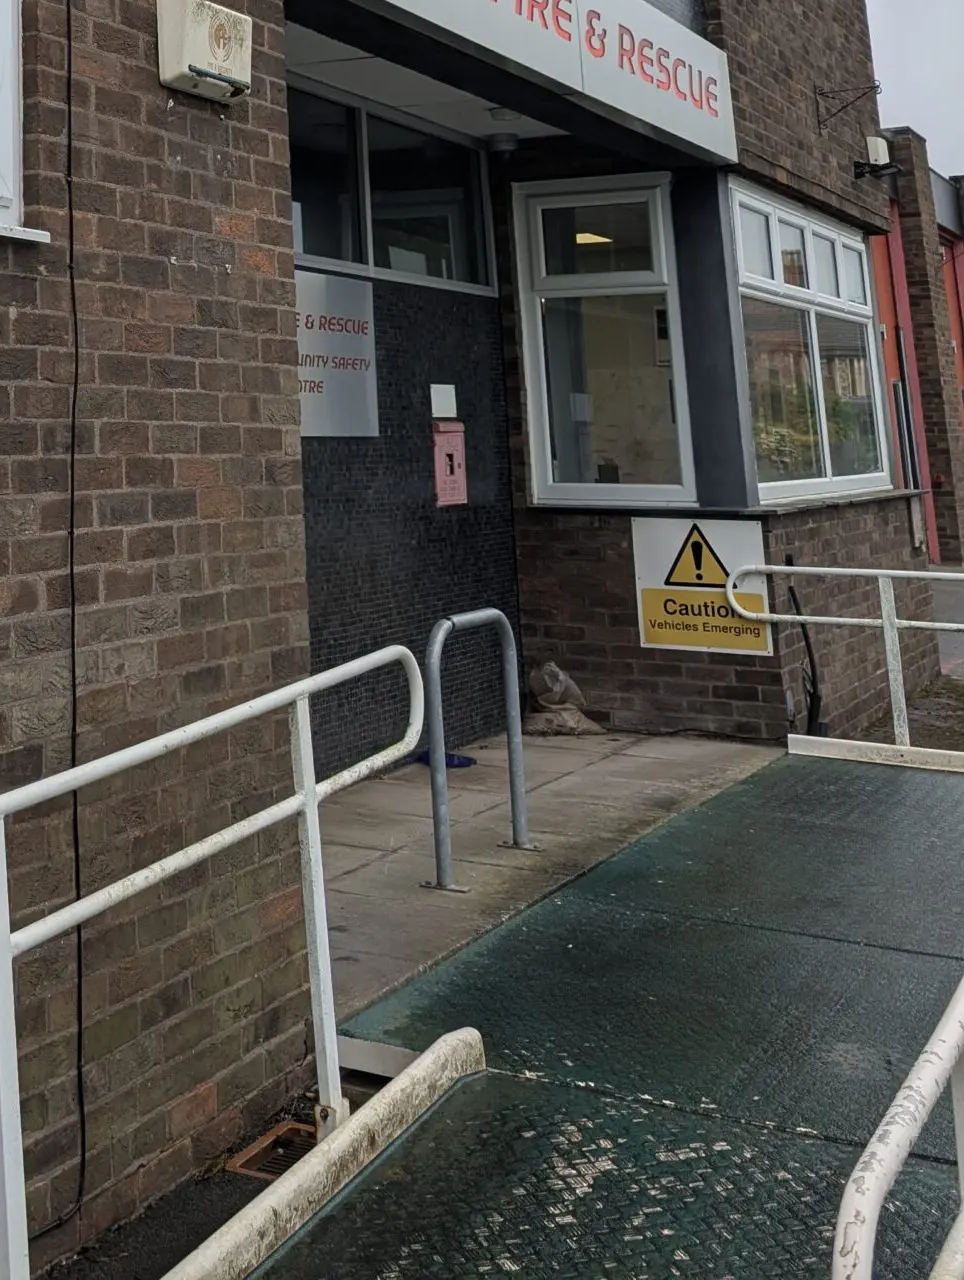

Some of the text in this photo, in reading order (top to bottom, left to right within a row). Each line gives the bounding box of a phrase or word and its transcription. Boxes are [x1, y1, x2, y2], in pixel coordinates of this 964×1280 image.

[585, 8, 607, 58] &
[618, 22, 719, 117] RESCUE
[304, 314, 314, 330] &
[318, 315, 369, 335] RESCUE
[297, 353, 371, 371] UNITY SAFETY
[663, 598, 742, 619] Cautio
[649, 619, 761, 638] Vehicles Emerging
